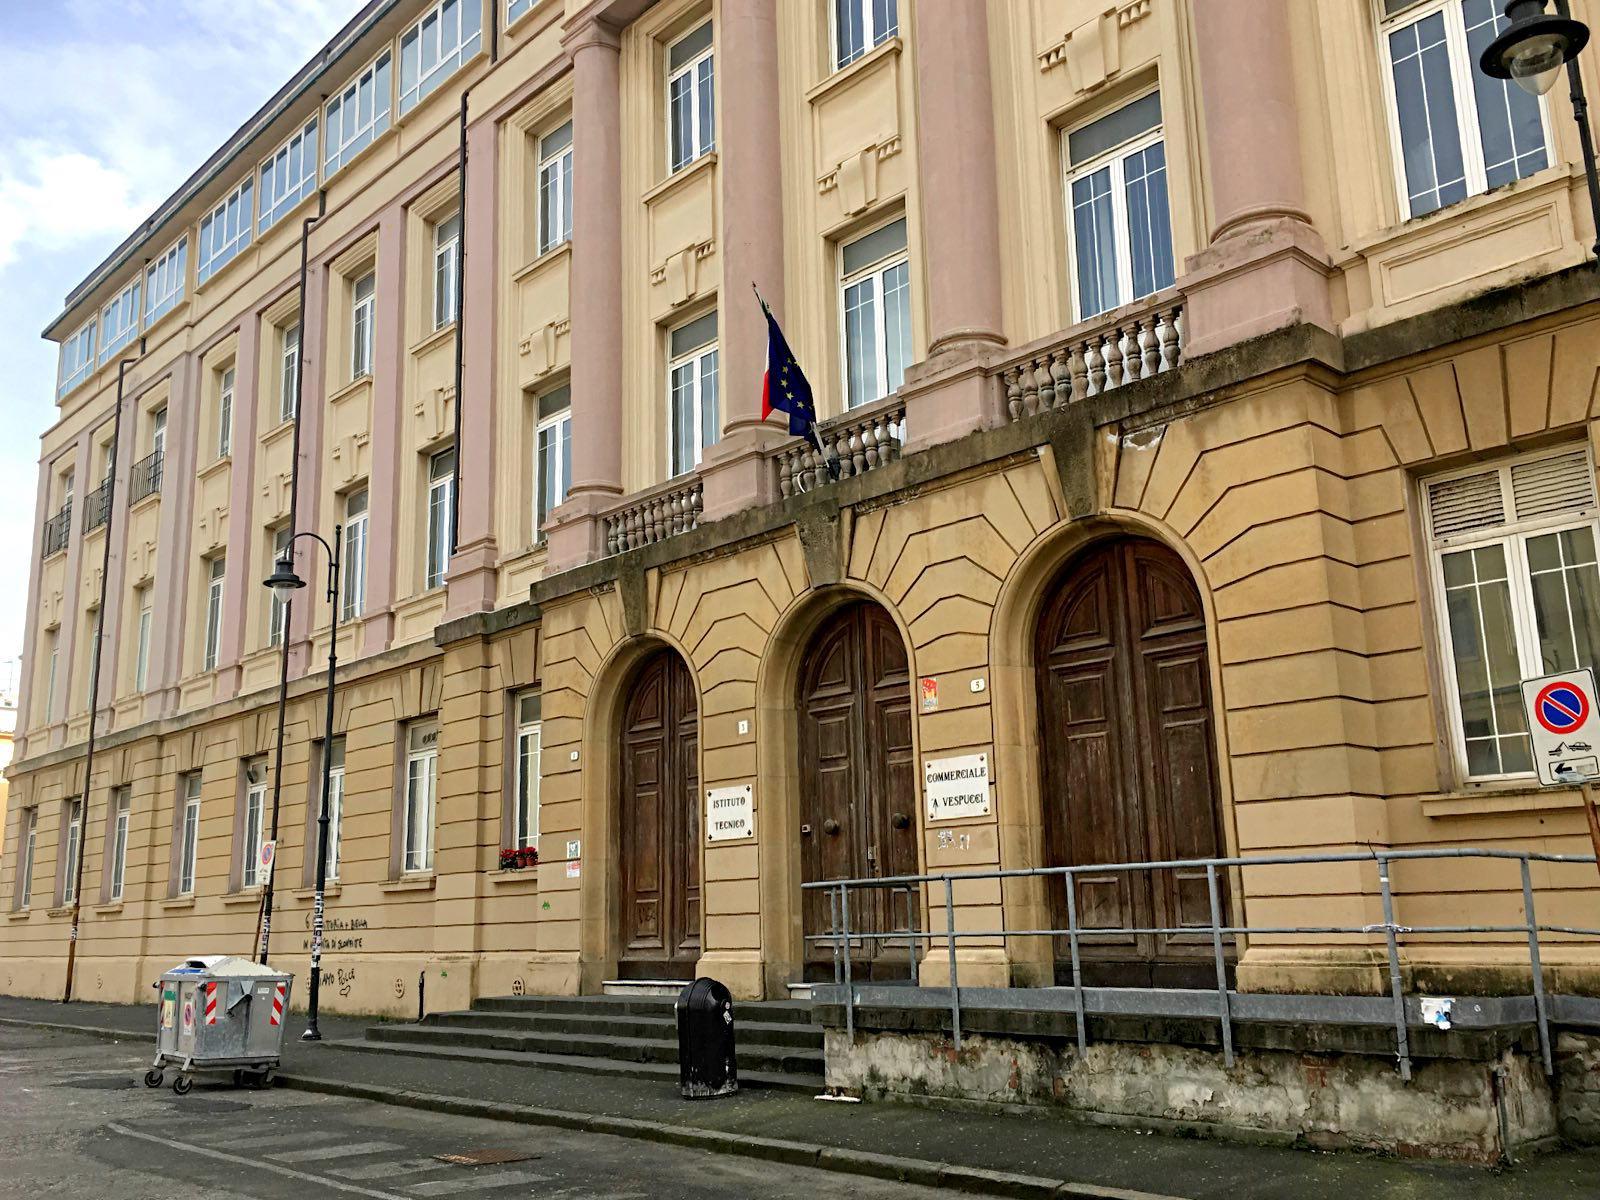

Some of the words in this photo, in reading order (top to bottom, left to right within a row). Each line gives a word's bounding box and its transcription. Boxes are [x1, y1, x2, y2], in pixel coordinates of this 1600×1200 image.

[975, 680, 980, 689] 5
[927, 767, 986, 783] COMMERCIALE
[713, 796, 746, 808] ISTITUTO
[714, 819, 745, 830] TECNICO
